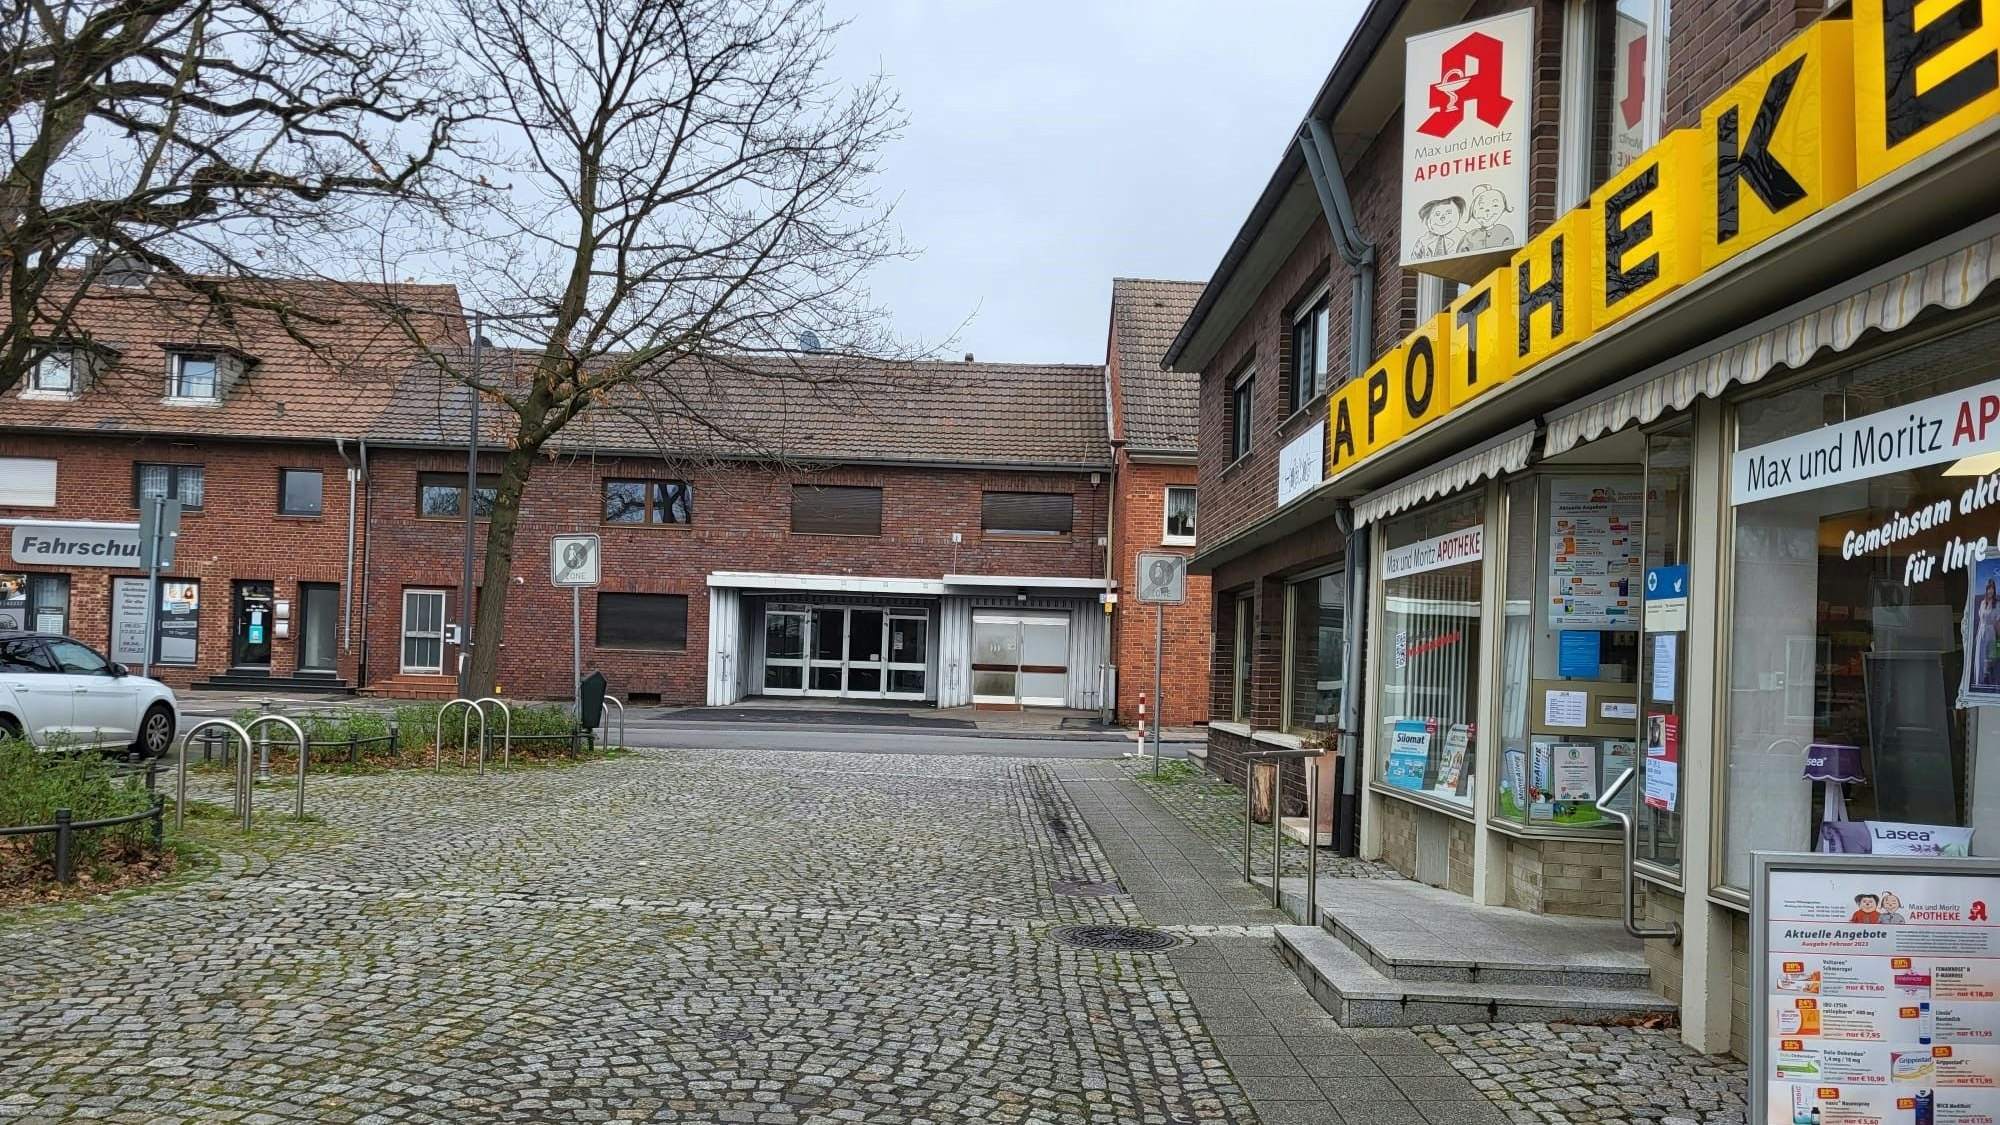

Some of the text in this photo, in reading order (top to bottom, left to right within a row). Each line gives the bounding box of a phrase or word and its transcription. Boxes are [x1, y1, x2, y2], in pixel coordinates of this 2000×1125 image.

[1415, 131, 1512, 160] Max und Moritz
[1415, 149, 1512, 182] APOTHEKE
[1332, 0, 1998, 466] APOTHEKE
[1747, 455, 1792, 492] Max
[1799, 432, 1843, 481] und
[1852, 414, 1943, 469] Moritz
[1842, 498, 1952, 562] Gemeinsam
[1386, 531, 1481, 574] Max und Moritz APOTHEKE
[1904, 536, 1988, 587] für Ihre
[1396, 733, 1425, 745] Silomat
[1874, 827, 1930, 842] Lasea
[1909, 911, 1960, 921] APOTHEKE
[1784, 929, 1888, 941] Aktuelle Angebote
